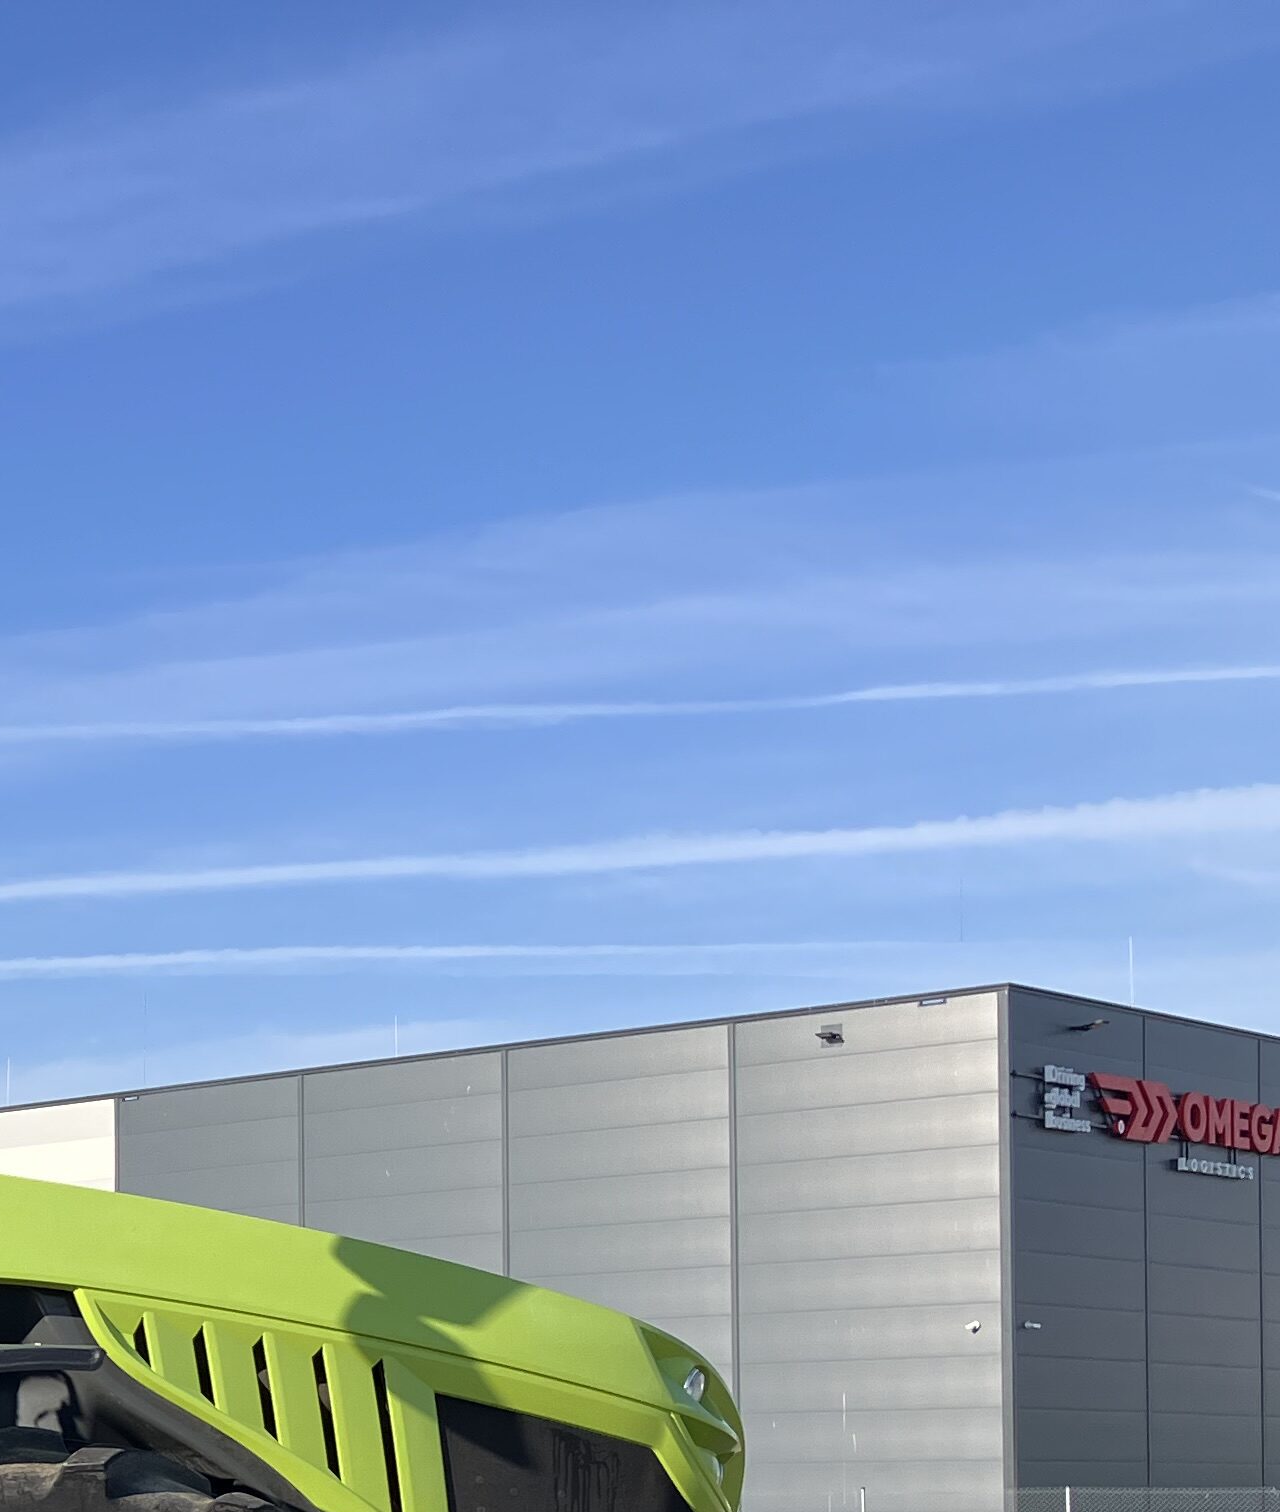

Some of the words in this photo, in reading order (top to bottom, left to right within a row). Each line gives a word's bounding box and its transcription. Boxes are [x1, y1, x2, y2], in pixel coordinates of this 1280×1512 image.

[1044, 1065, 1085, 1091] Driving
[1044, 1087, 1080, 1109] global
[1044, 1110, 1091, 1133] business
[1178, 1157, 1254, 1179] LOGISTICS
